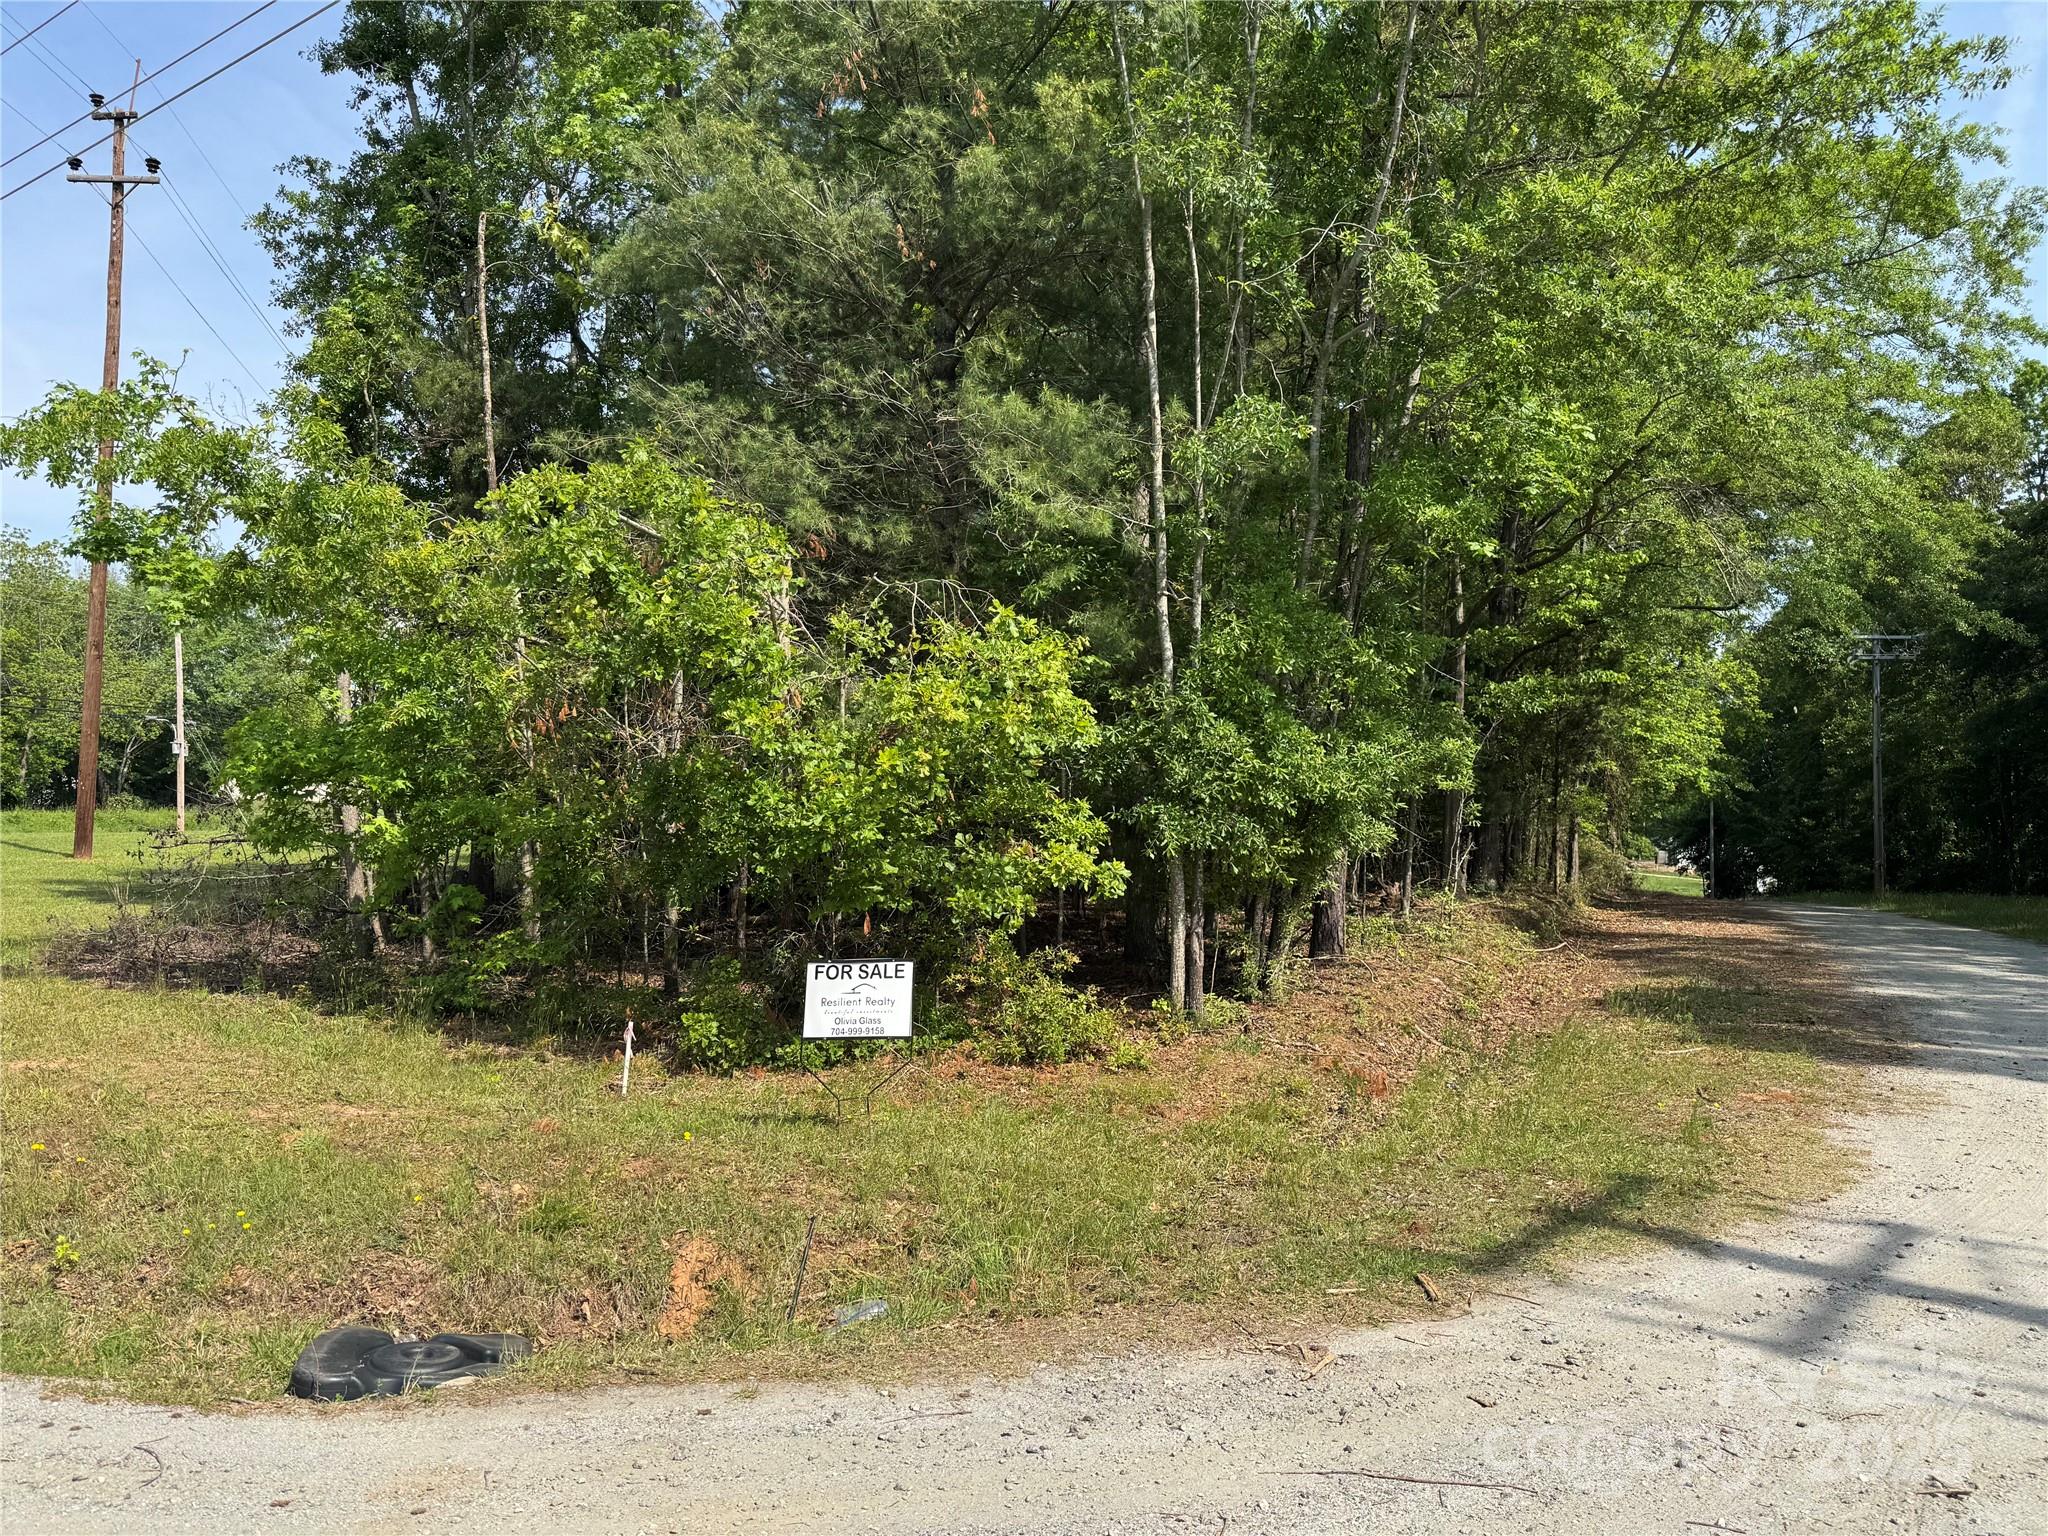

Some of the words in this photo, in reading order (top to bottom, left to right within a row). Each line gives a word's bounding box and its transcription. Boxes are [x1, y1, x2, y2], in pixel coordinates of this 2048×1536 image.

[814, 964, 853, 980] FOR
[858, 963, 906, 980] SALE
[820, 997, 862, 1007] Resilient
[865, 996, 896, 1008] Realty
[834, 1017, 857, 1026] Olivia
[858, 1016, 882, 1025] Glass
[831, 1027, 885, 1036] 704-999-9158
